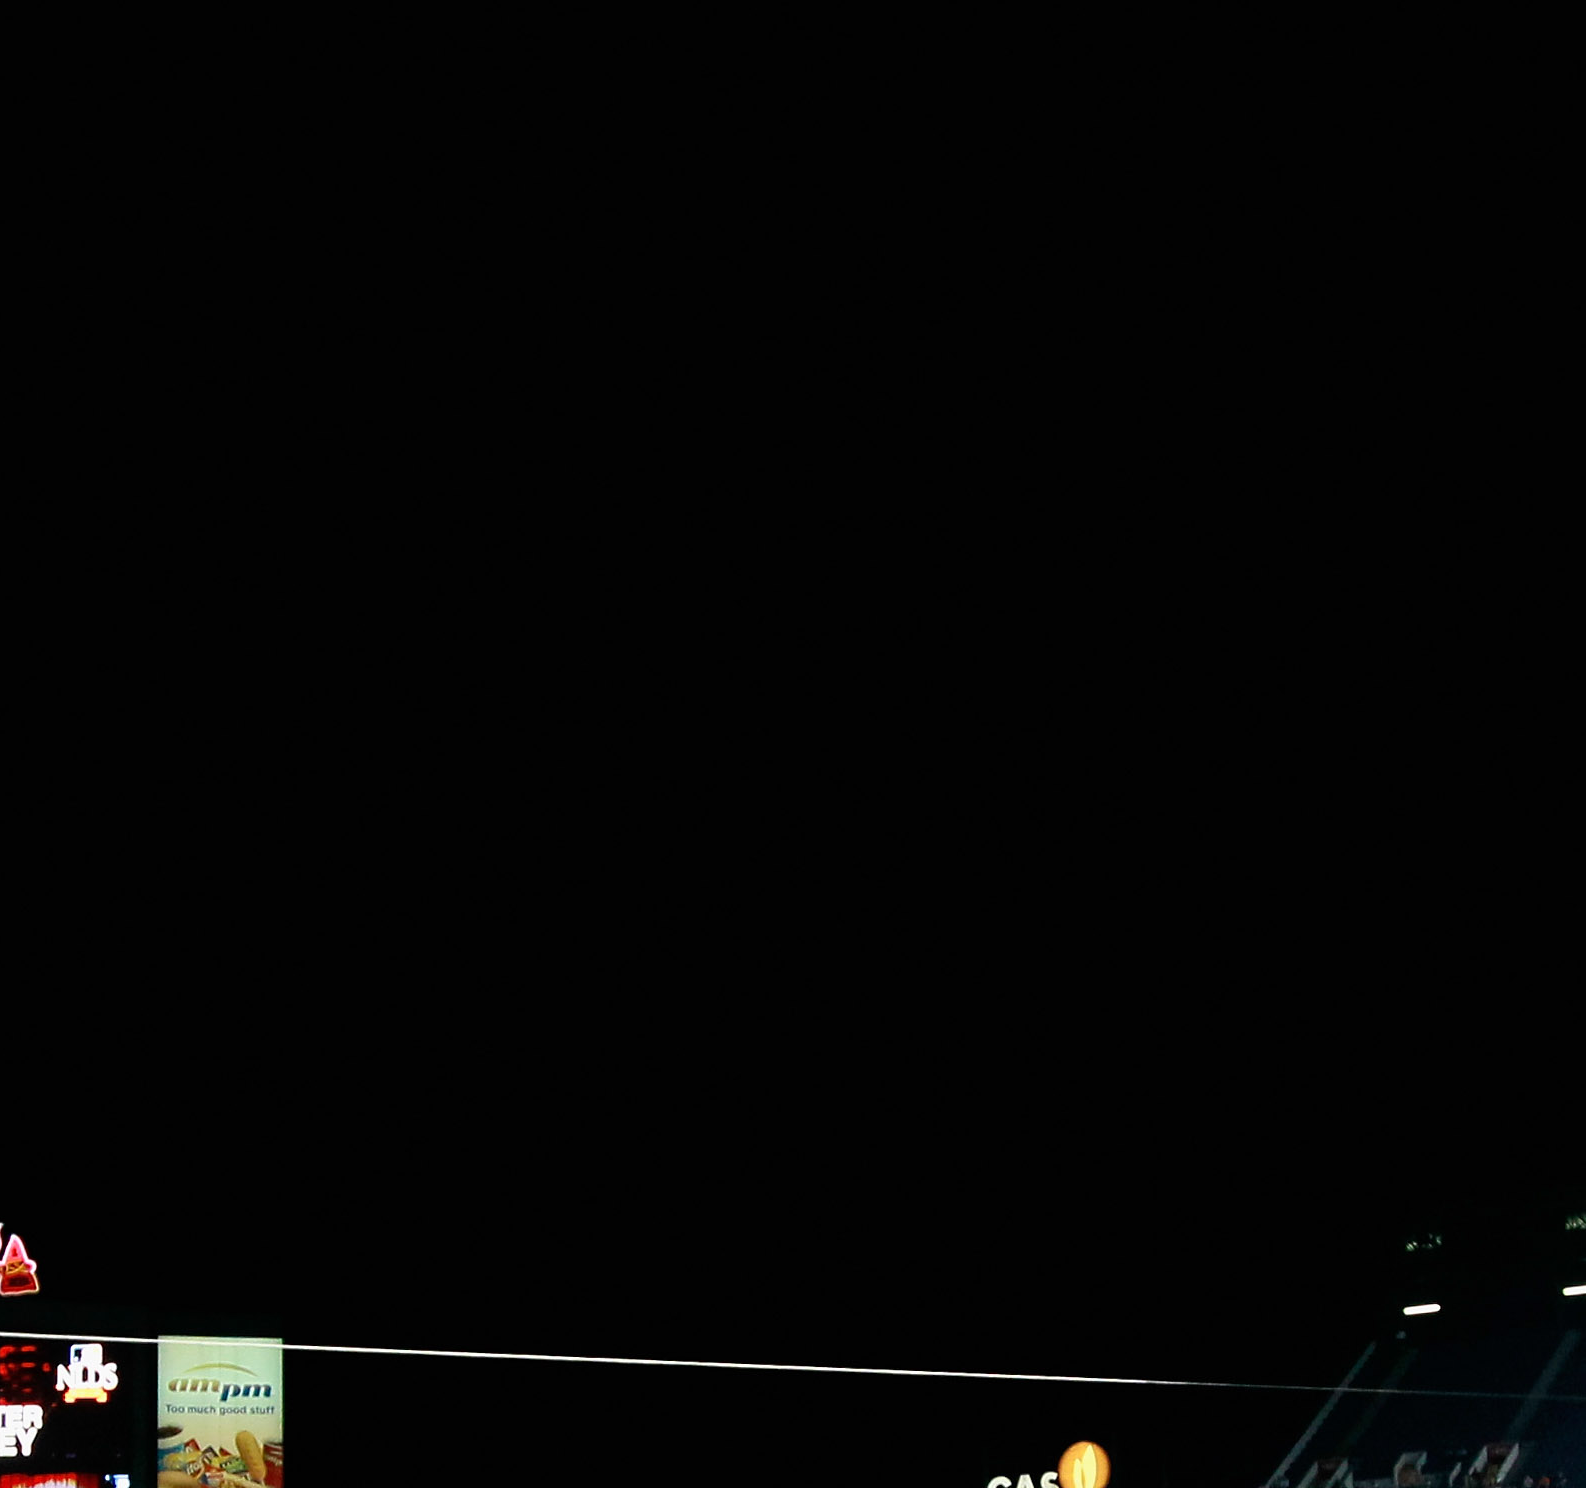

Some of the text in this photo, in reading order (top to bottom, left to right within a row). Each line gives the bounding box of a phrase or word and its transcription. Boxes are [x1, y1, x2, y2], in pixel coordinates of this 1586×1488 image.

[55, 1362, 119, 1392] NLDS
[168, 1378, 273, 1402] ampm
[166, 1404, 275, 1416] Too much good stuff
